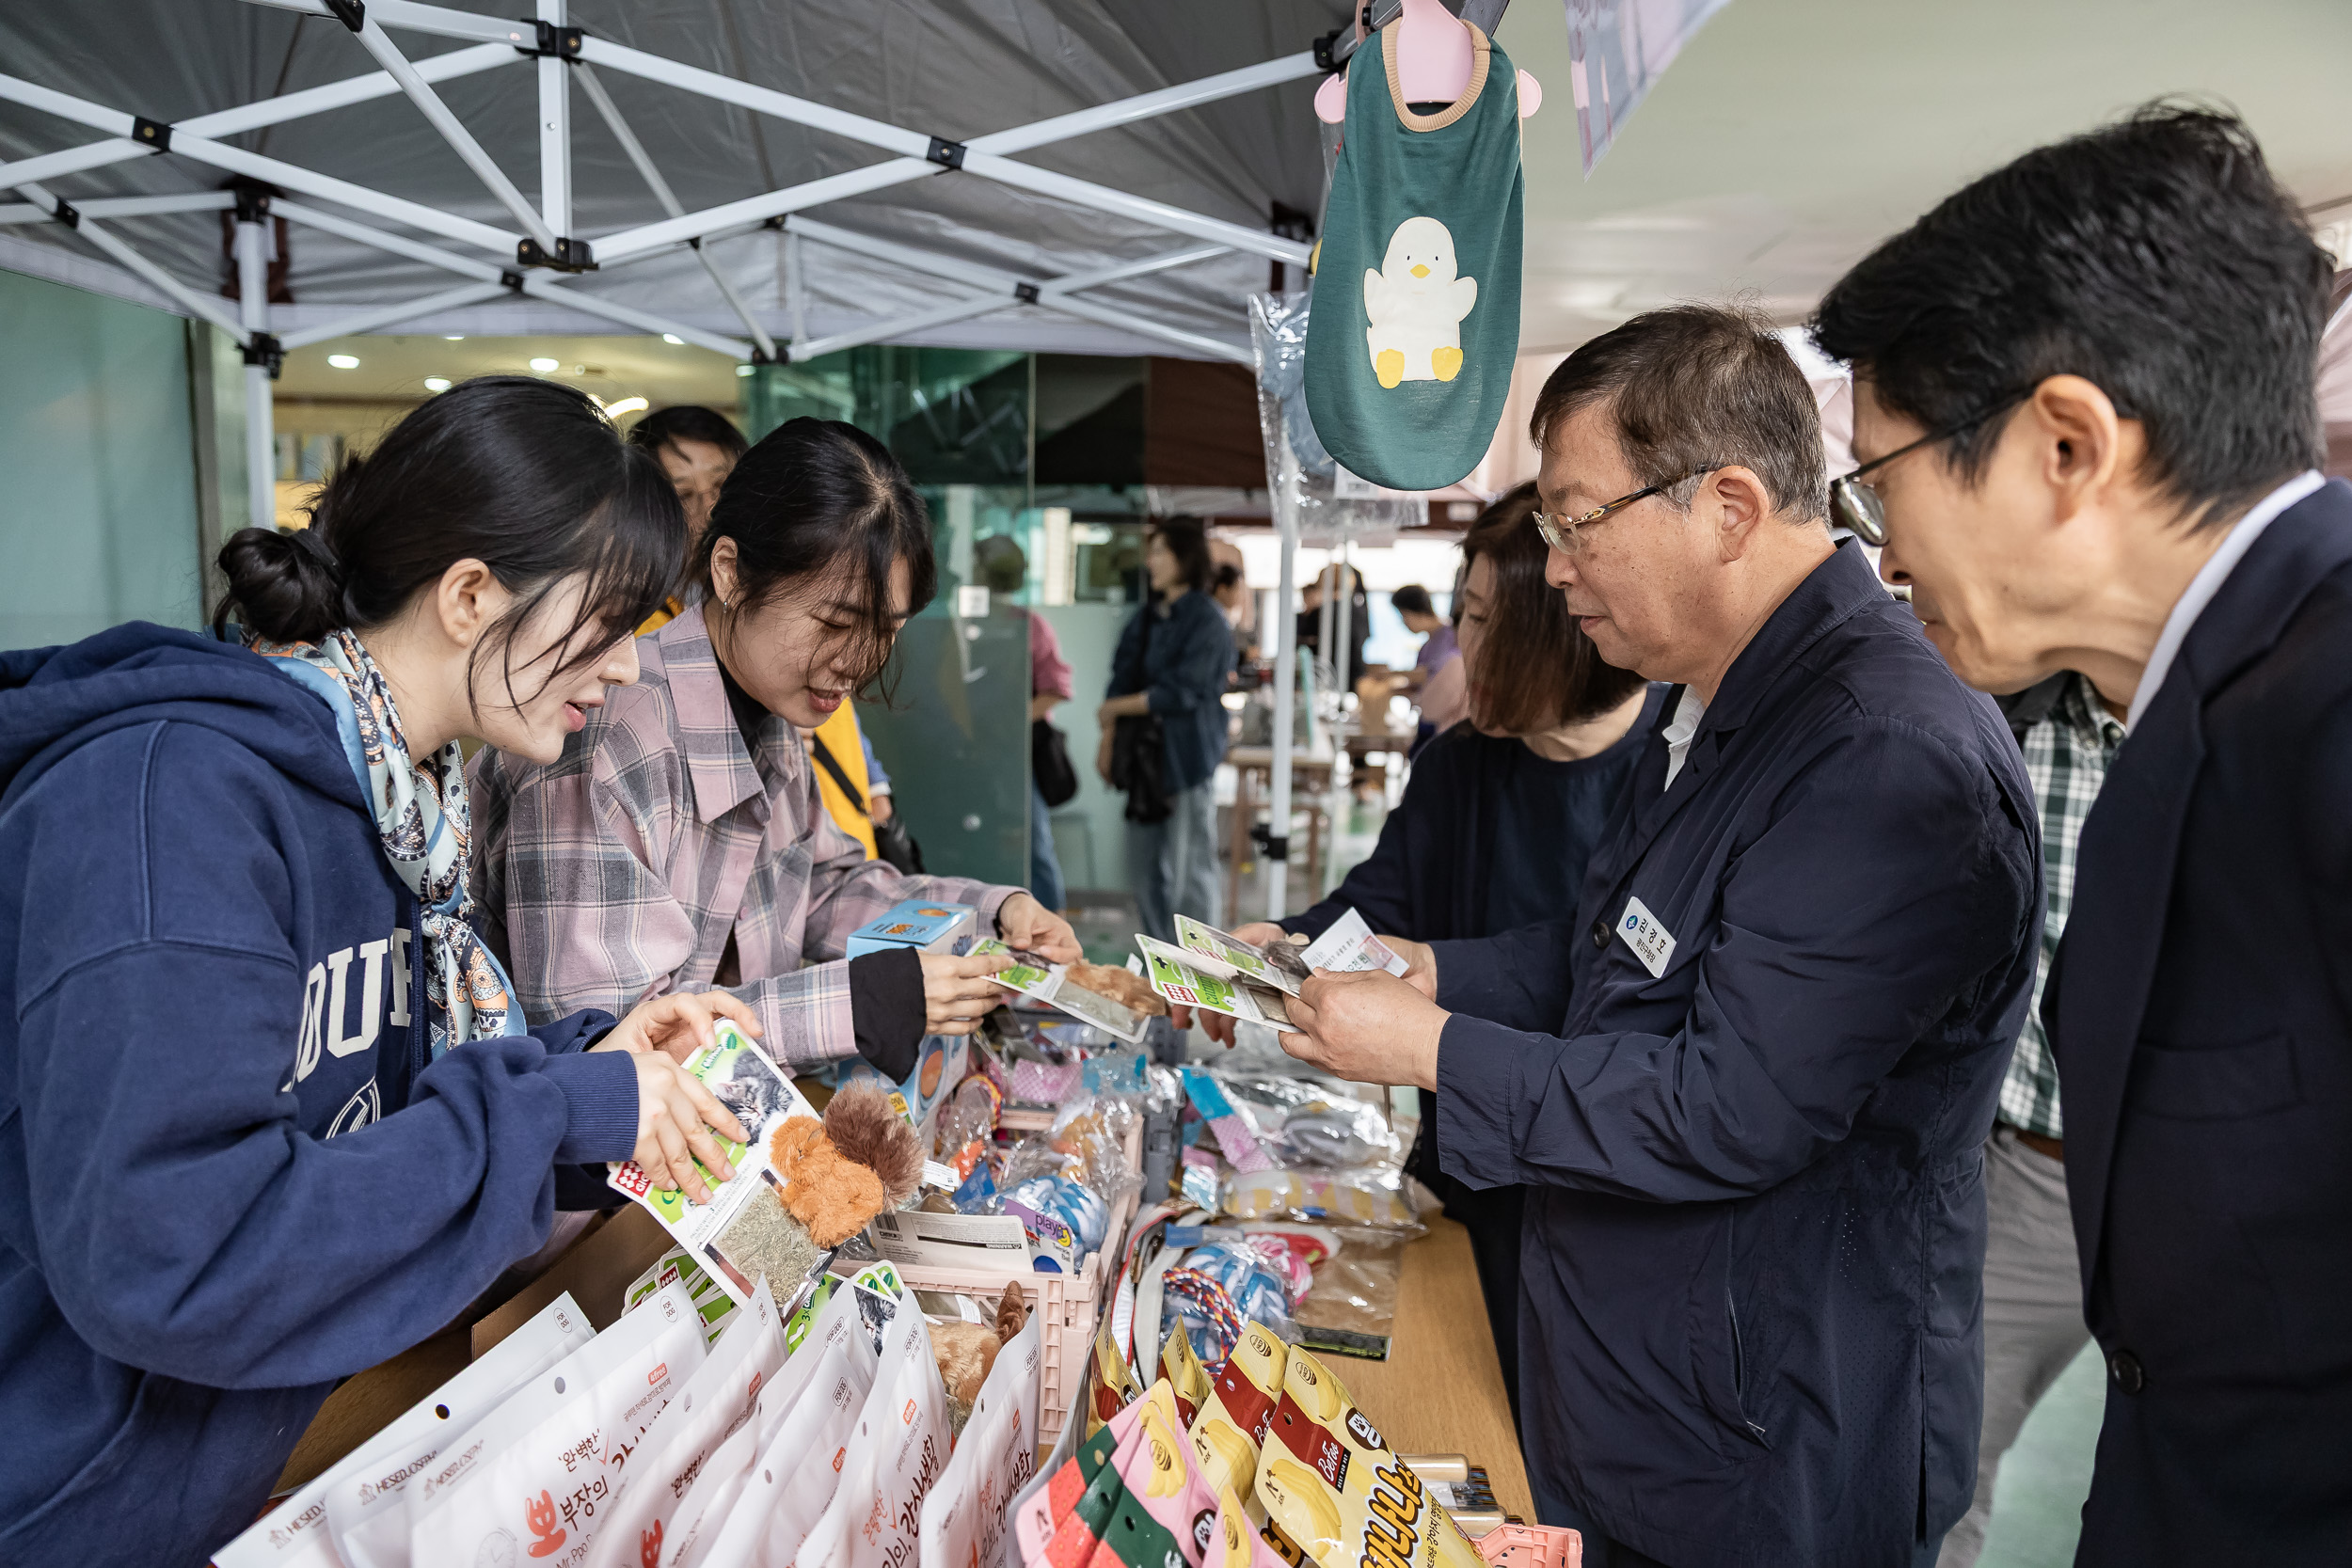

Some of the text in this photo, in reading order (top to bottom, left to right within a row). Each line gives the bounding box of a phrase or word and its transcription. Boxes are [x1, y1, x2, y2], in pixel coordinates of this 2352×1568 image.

[663, 1301, 672, 1309] FOR
[666, 1308, 675, 1317] DOG
[561, 1320, 570, 1328] DOG
[834, 1322, 843, 1334] DOG
[910, 1327, 918, 1342] DOG
[650, 1366, 666, 1383] 4free
[834, 1389, 843, 1402] FOR
[1427, 1517, 1441, 1545] 강아지
